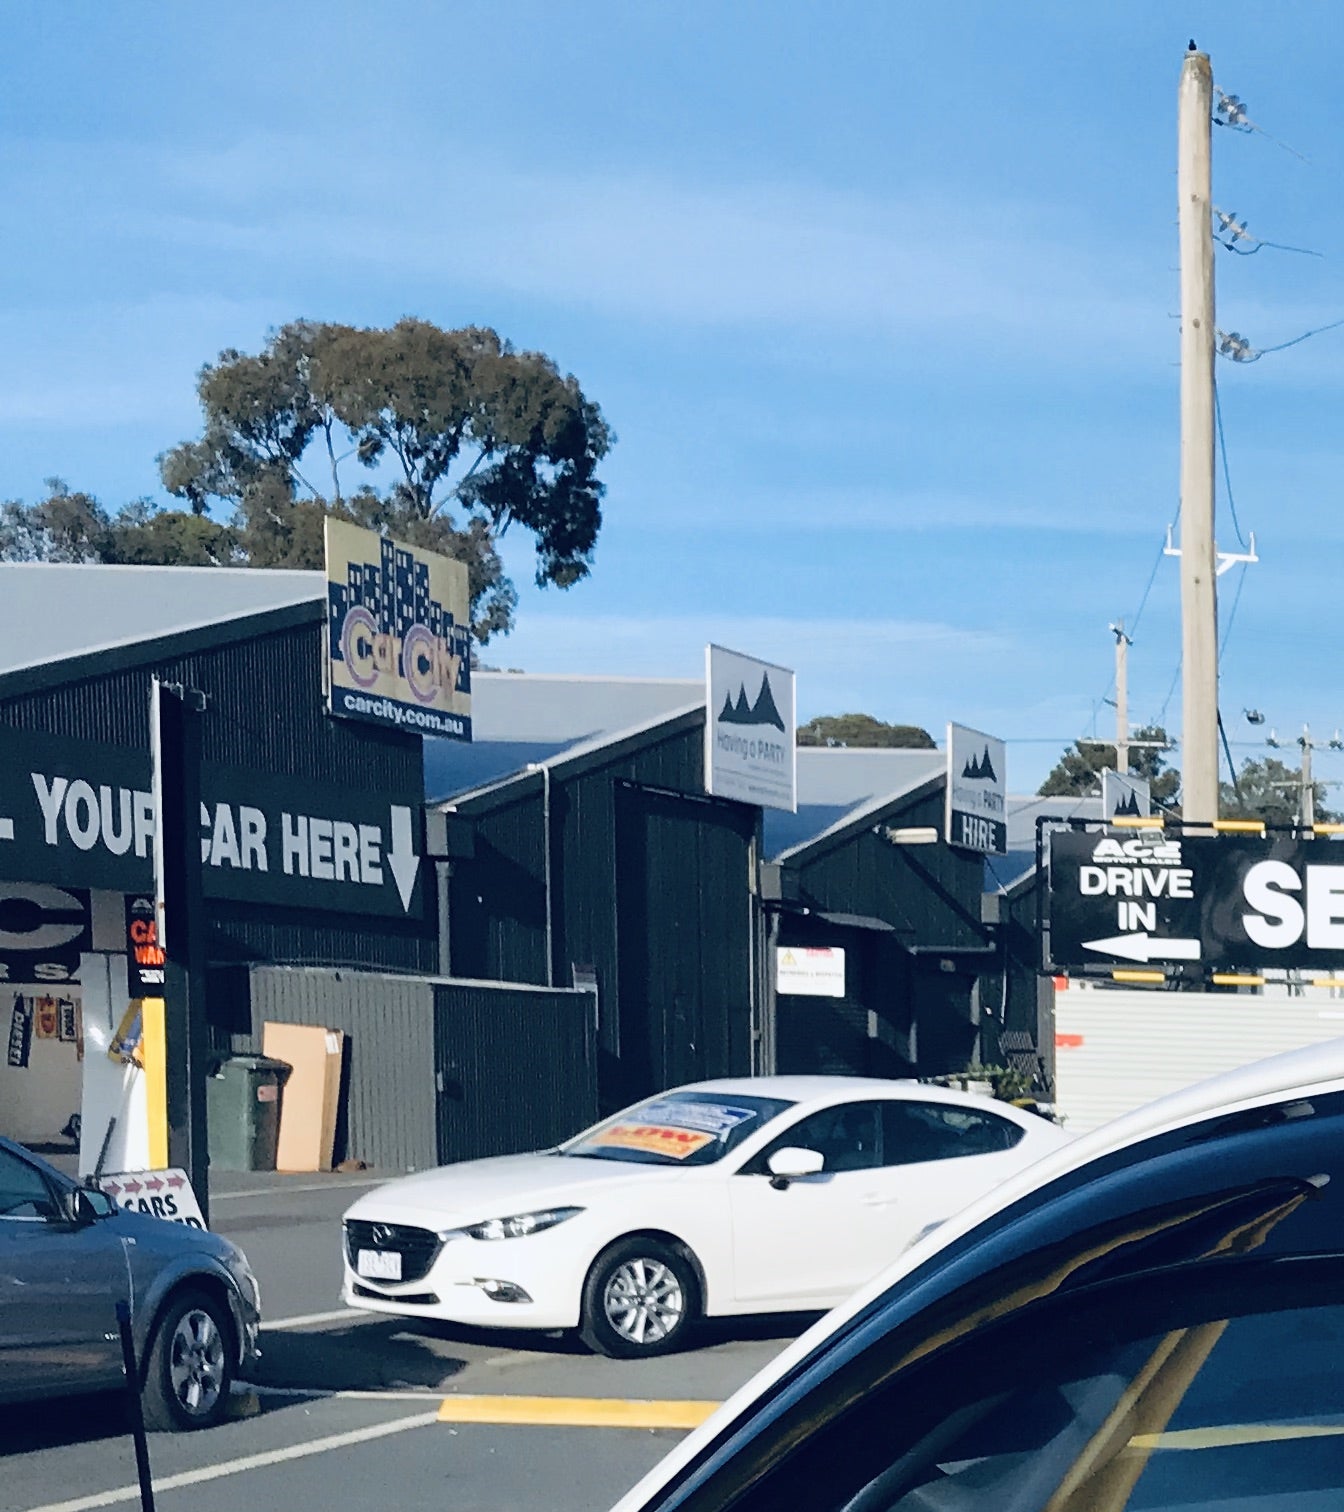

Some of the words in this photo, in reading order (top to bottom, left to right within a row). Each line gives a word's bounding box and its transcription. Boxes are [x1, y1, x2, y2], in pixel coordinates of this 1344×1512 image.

[344, 695, 463, 734] carcity.com.au
[281, 812, 384, 885] HERE
[962, 815, 997, 851] HIRE
[1093, 838, 1182, 859] ACE
[1080, 866, 1195, 898] DRIVE
[1118, 901, 1156, 931] IN
